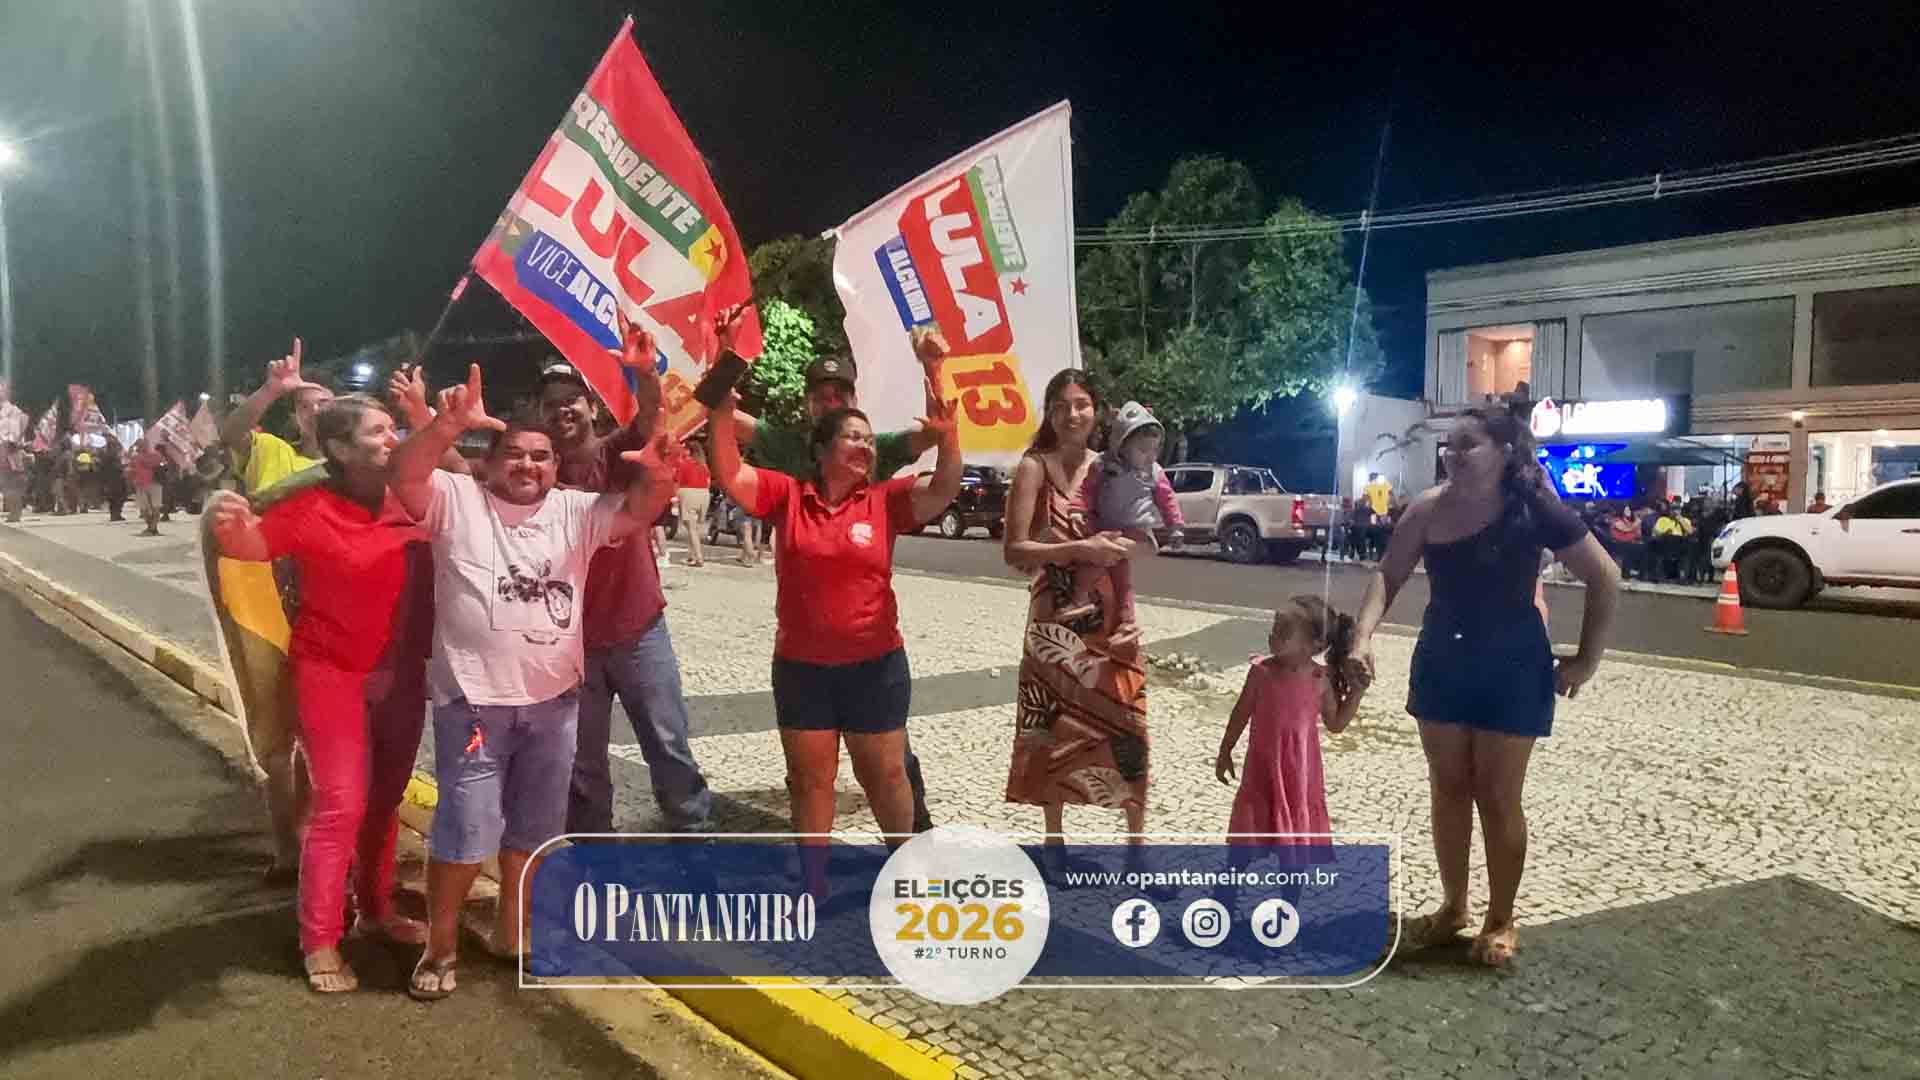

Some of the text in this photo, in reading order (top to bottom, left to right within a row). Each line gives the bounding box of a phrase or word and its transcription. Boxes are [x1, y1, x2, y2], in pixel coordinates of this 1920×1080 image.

[572, 93, 702, 234] RESIDENTE
[924, 180, 1001, 342] LULA
[952, 361, 1026, 427] 13
